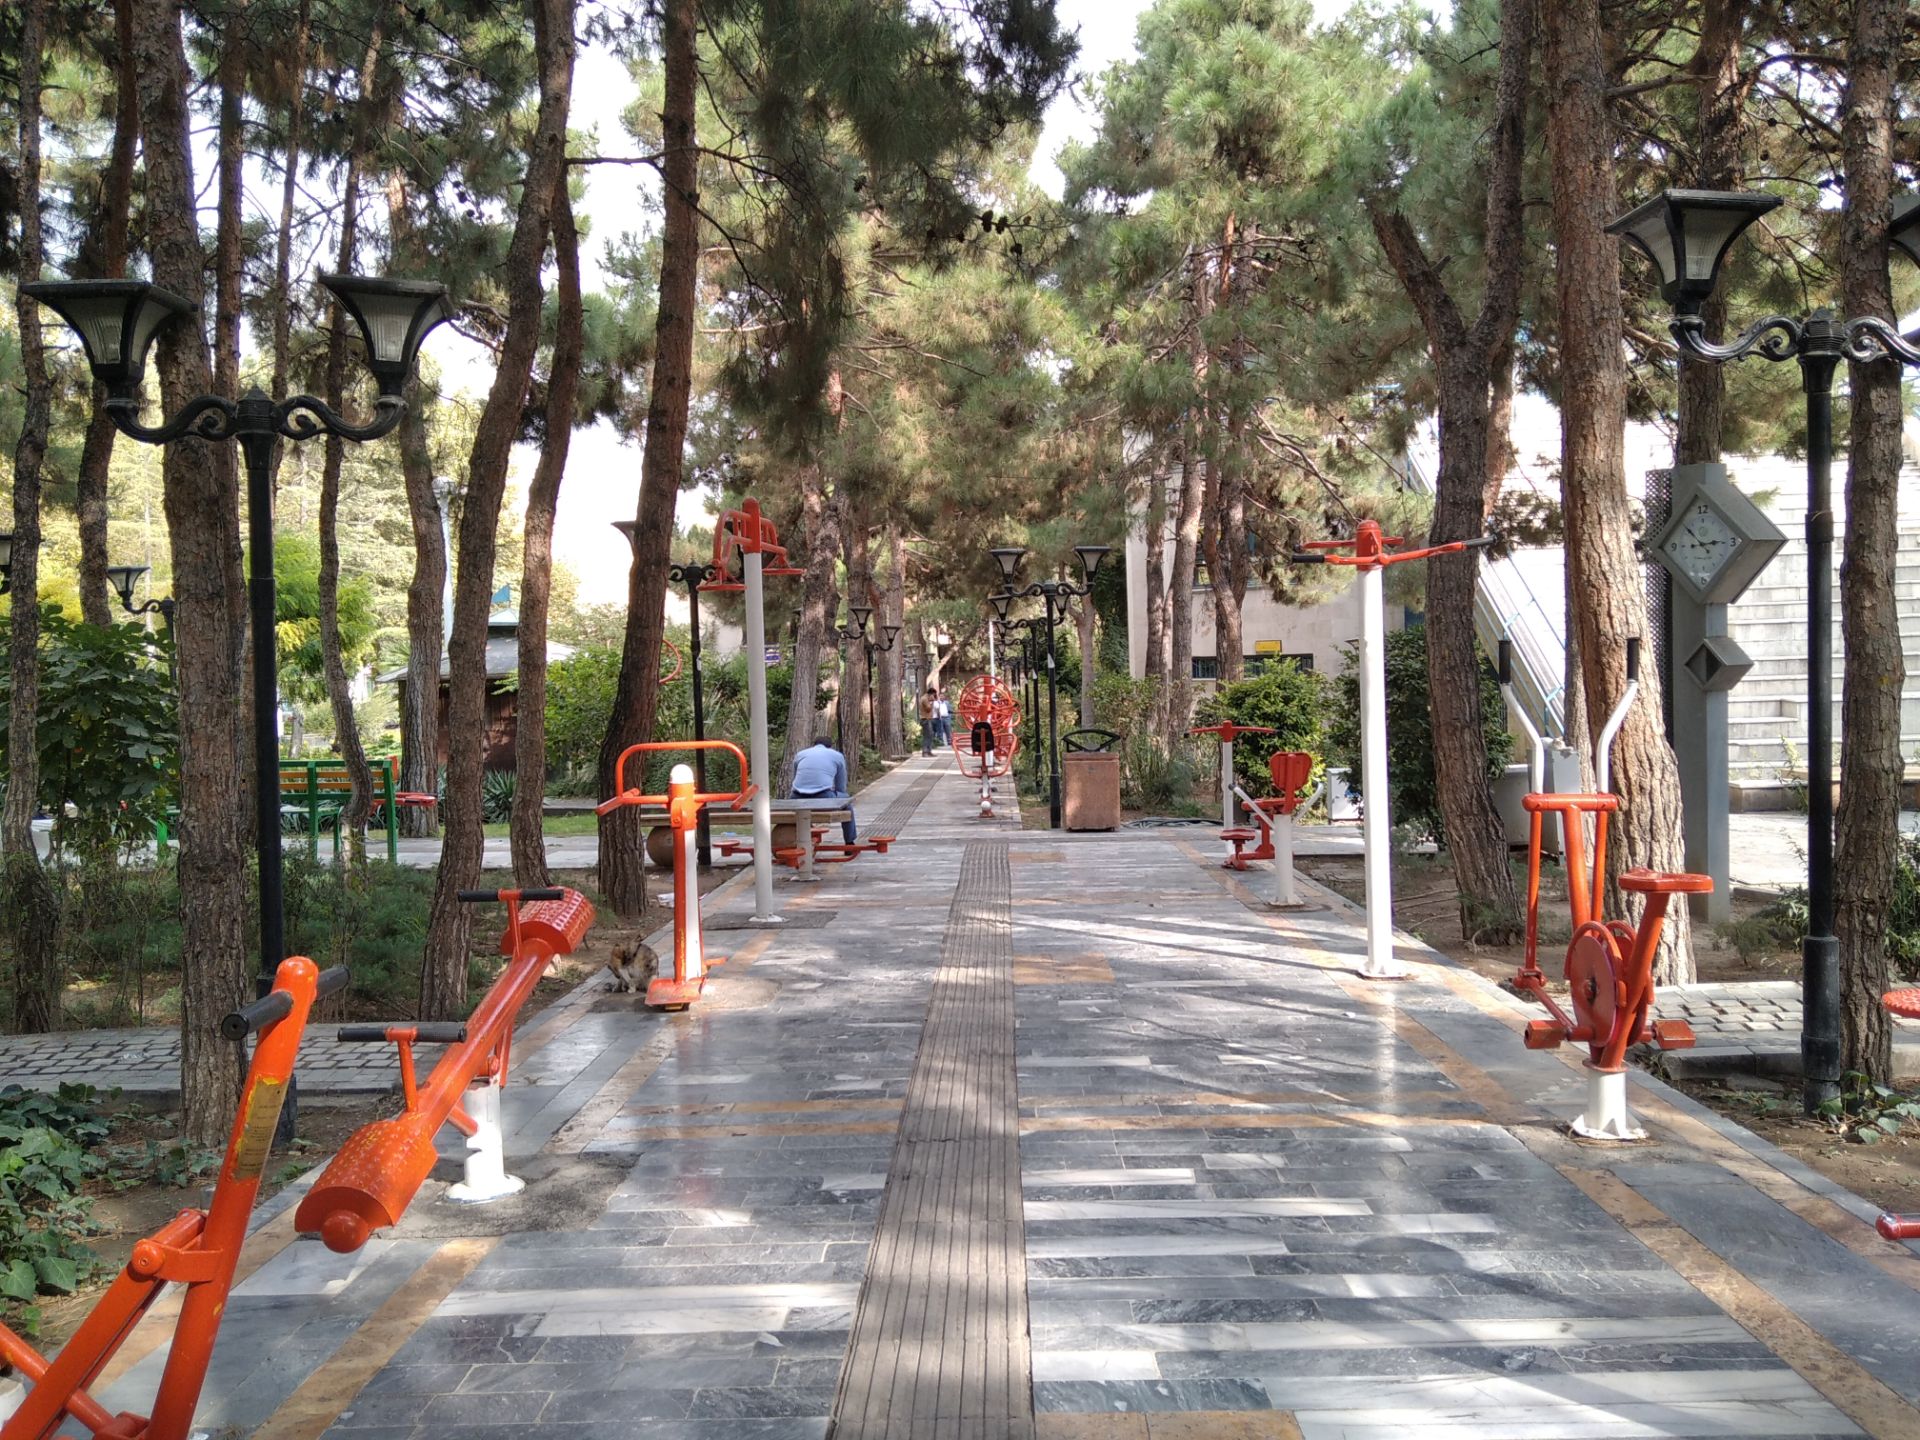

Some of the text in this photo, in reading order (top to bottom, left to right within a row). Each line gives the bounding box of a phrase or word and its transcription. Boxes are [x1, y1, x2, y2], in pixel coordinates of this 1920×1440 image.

[1697, 504, 1709, 514] 12
[1671, 542, 1678, 552] 9
[1730, 537, 1737, 547] 3
